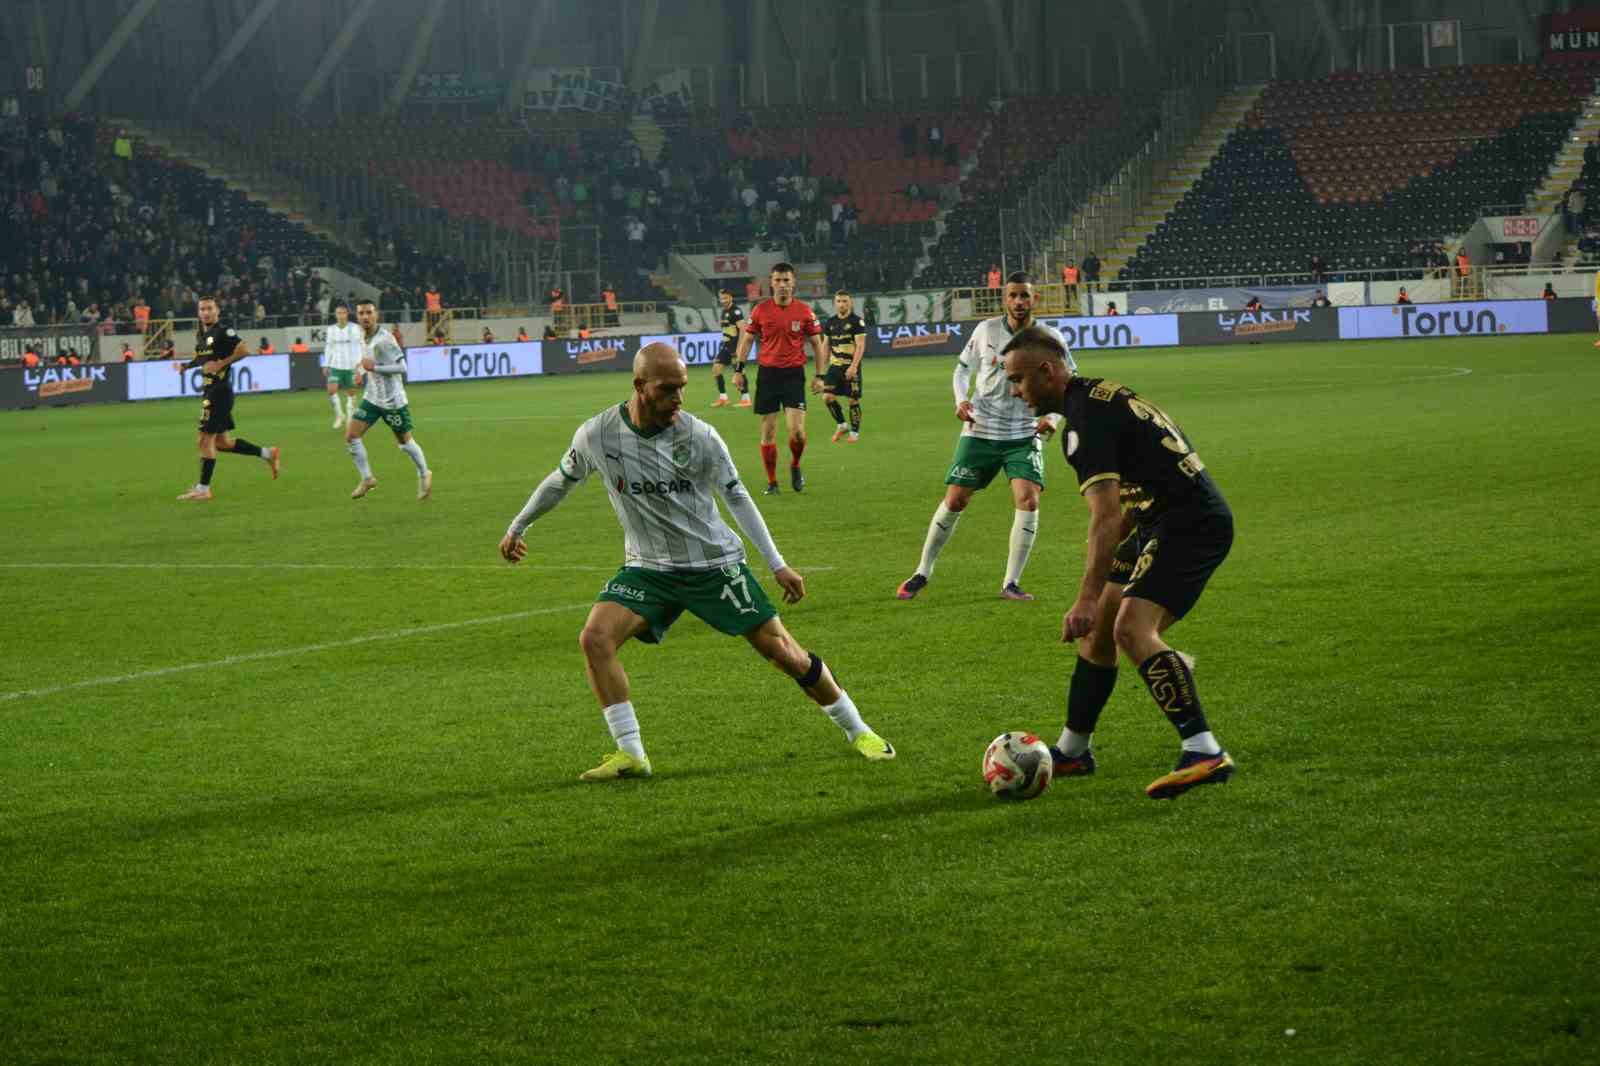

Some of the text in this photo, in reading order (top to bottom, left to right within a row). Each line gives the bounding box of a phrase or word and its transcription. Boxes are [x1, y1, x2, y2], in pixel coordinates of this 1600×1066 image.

[1550, 27, 1600, 49] MÜN
[631, 479, 692, 495] SOCAR
[720, 575, 753, 610] 17
